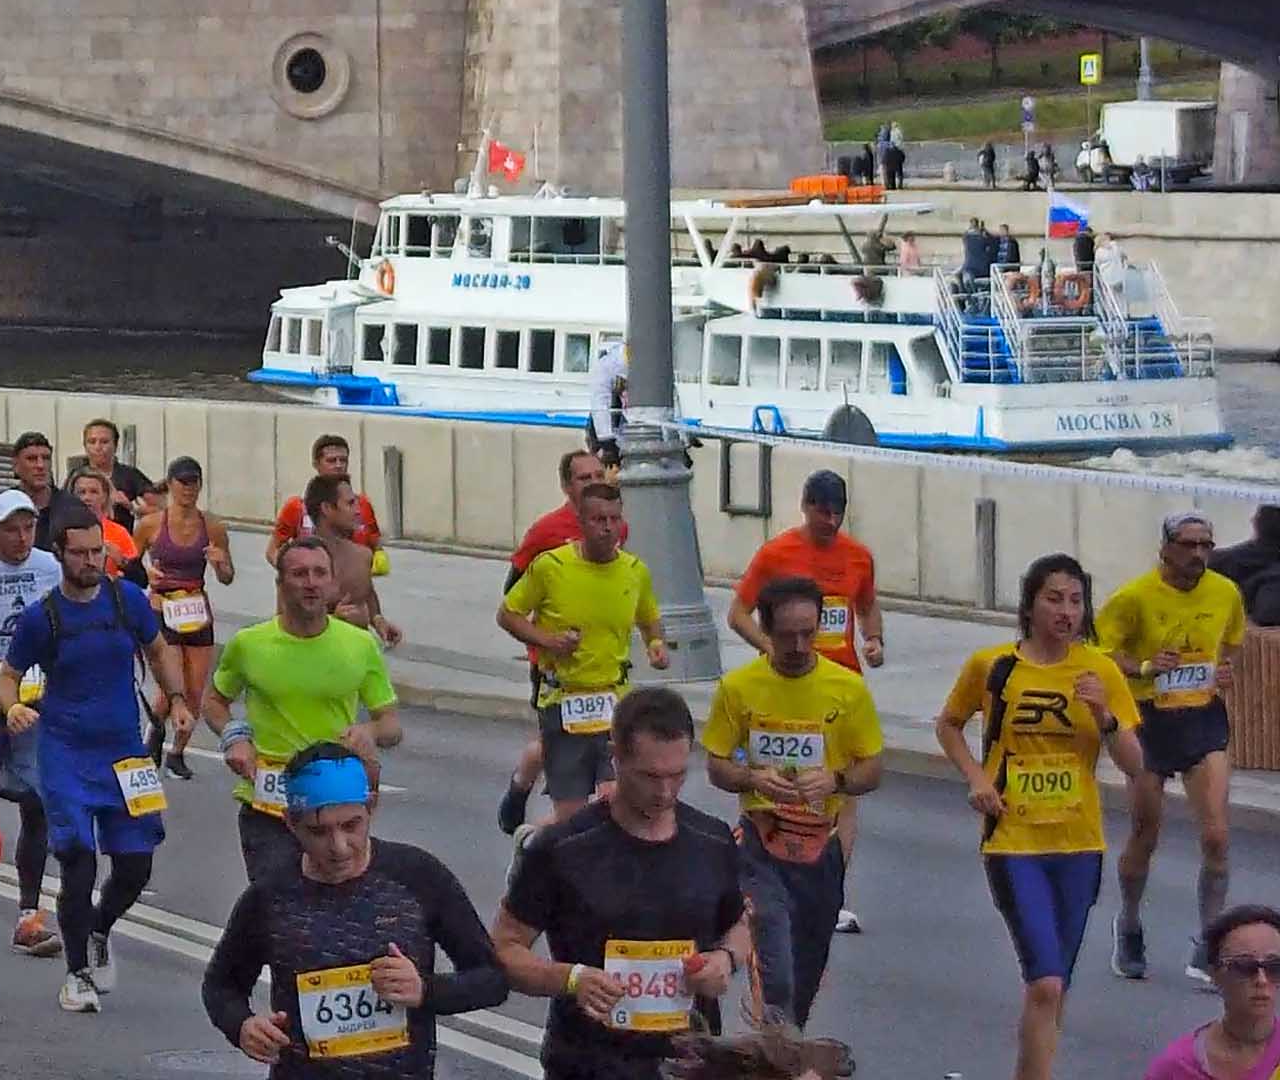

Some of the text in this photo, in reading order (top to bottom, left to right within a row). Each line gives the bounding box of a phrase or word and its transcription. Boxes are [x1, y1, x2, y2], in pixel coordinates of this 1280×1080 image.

[1056, 410, 1173, 432] МОСКВА 28
[759, 735, 813, 757] 2326
[1017, 771, 1072, 793] 7090
